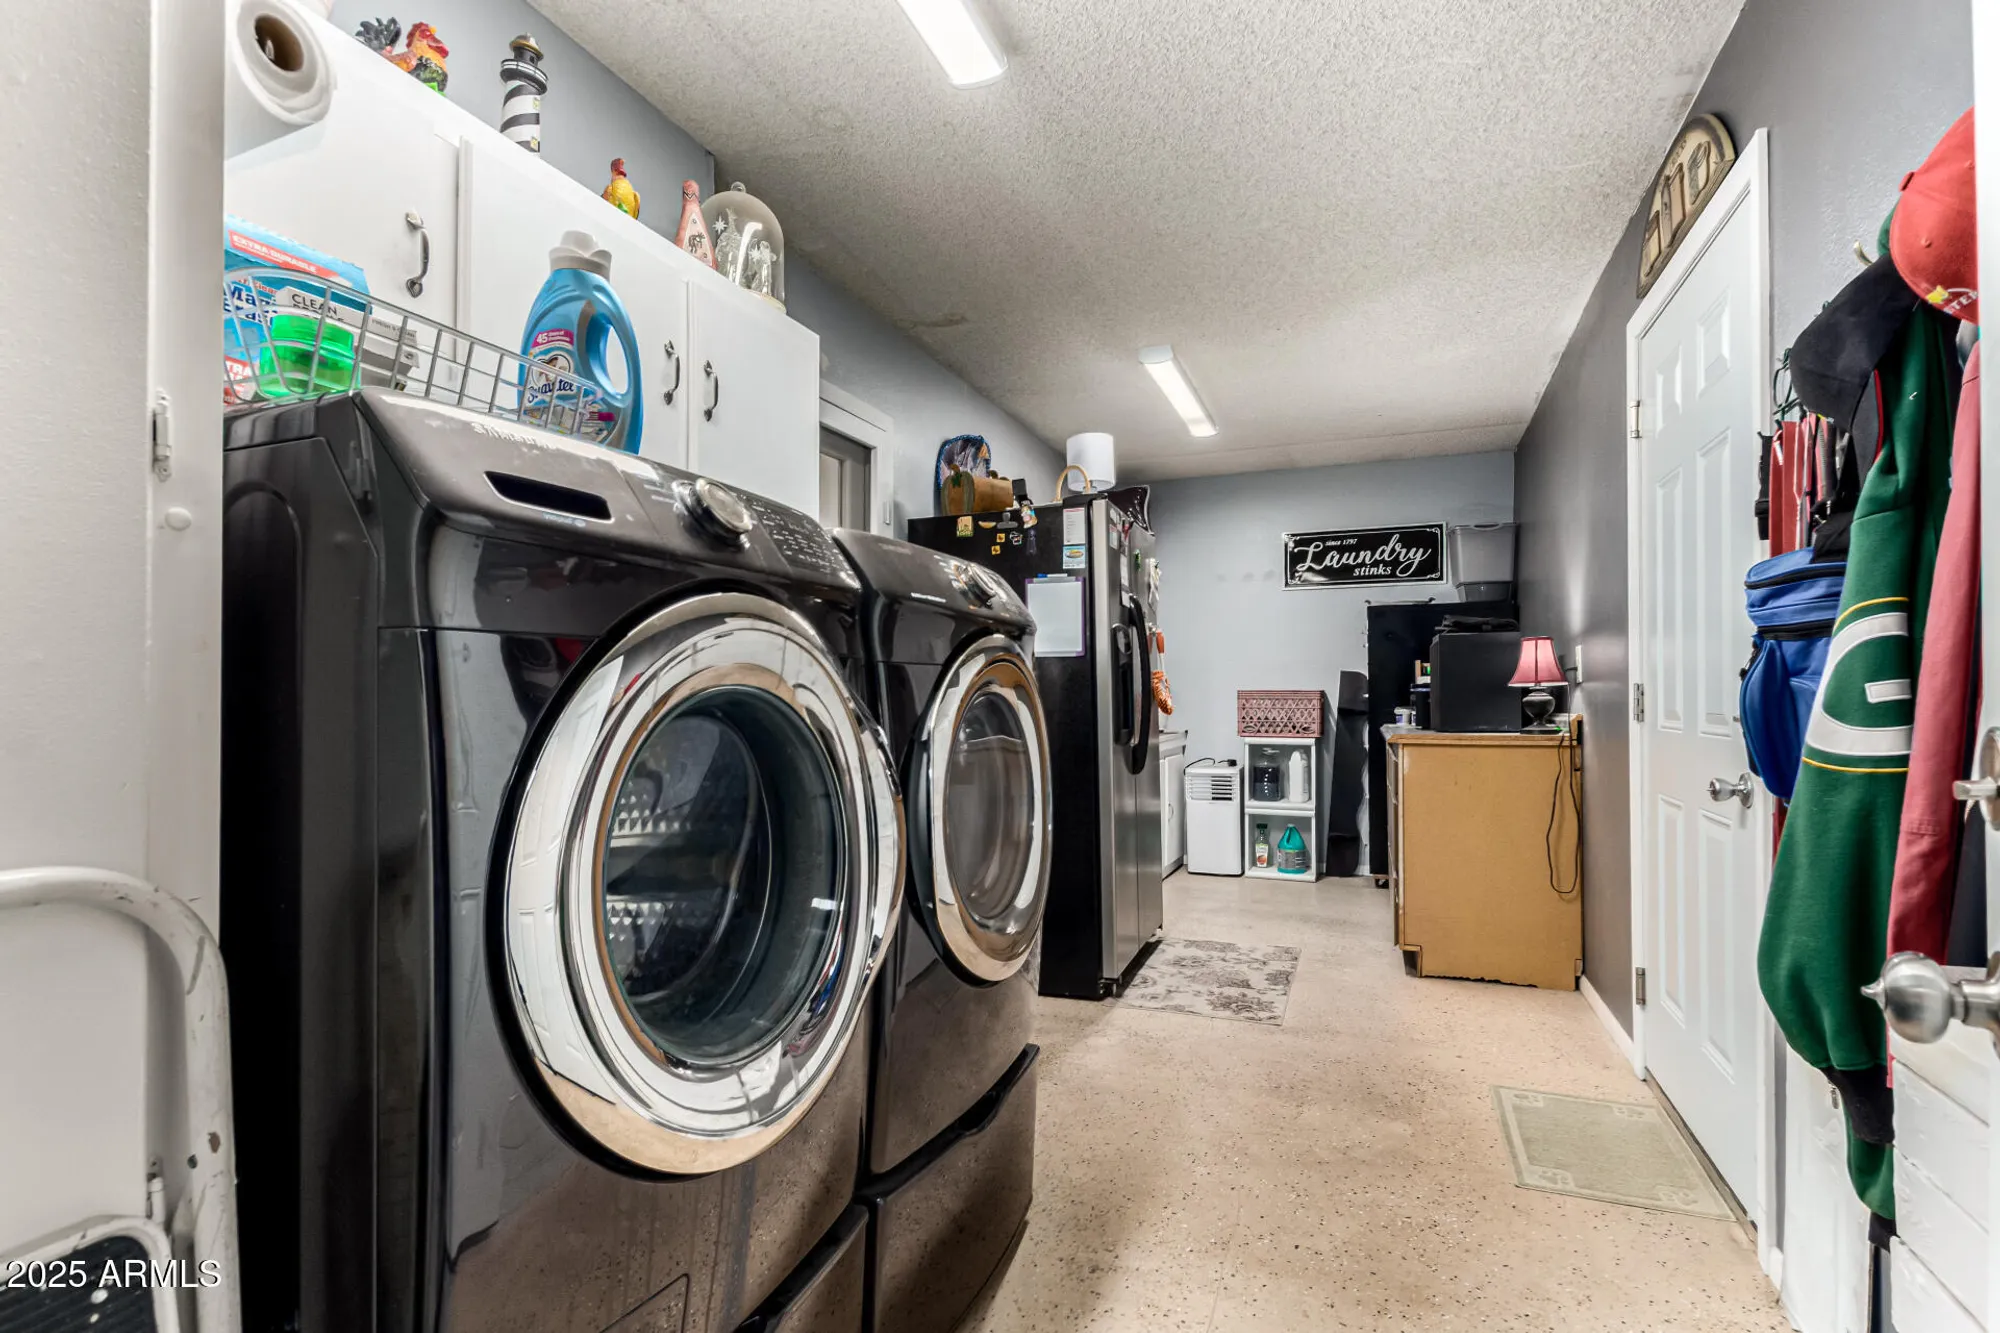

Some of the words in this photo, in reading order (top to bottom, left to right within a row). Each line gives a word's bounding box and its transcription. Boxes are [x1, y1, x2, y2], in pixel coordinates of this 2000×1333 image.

[536, 333, 549, 343] 45
[1294, 534, 1431, 577] Laundry
[1353, 564, 1392, 577] stinks
